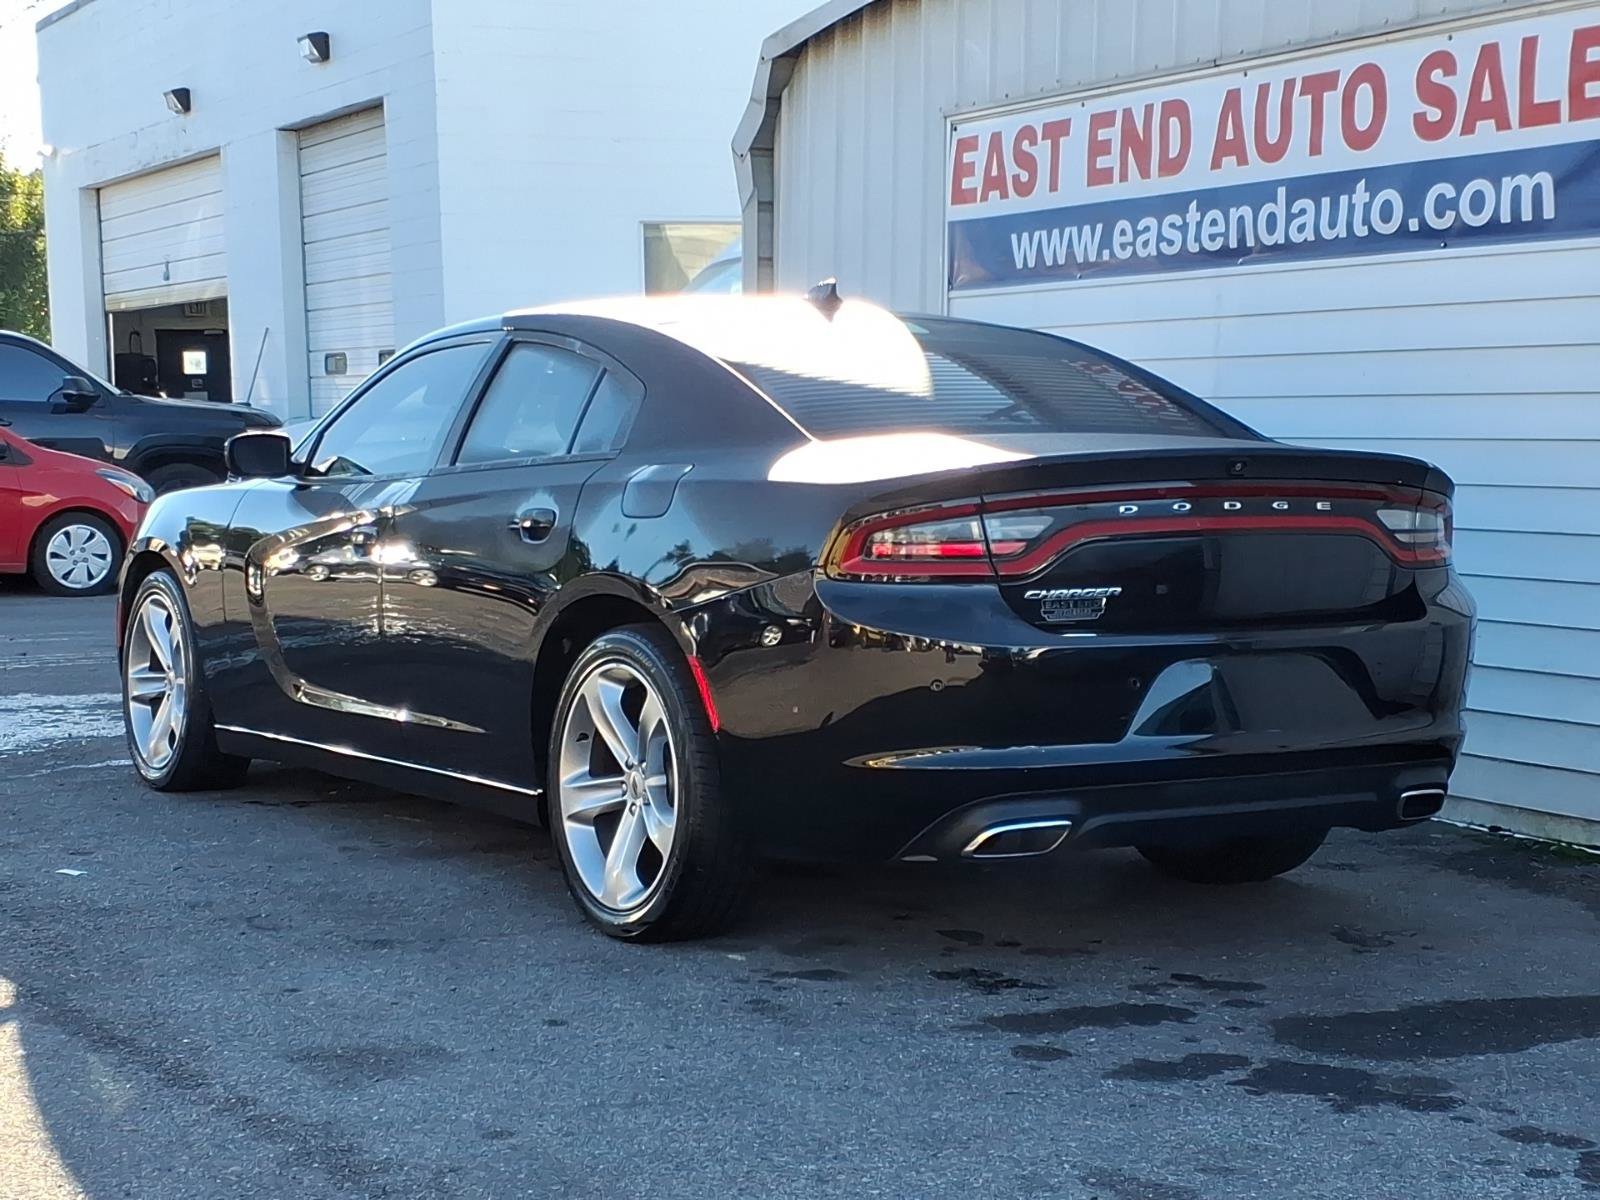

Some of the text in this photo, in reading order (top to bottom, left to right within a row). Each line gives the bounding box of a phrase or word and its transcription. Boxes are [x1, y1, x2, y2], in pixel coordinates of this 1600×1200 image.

[951, 26, 1600, 206] EAST END AUTO SALE
[1010, 171, 1556, 270] www.eastendauto.com
[1119, 501, 1332, 514] DODGE
[1024, 587, 1123, 600] CHARGER
